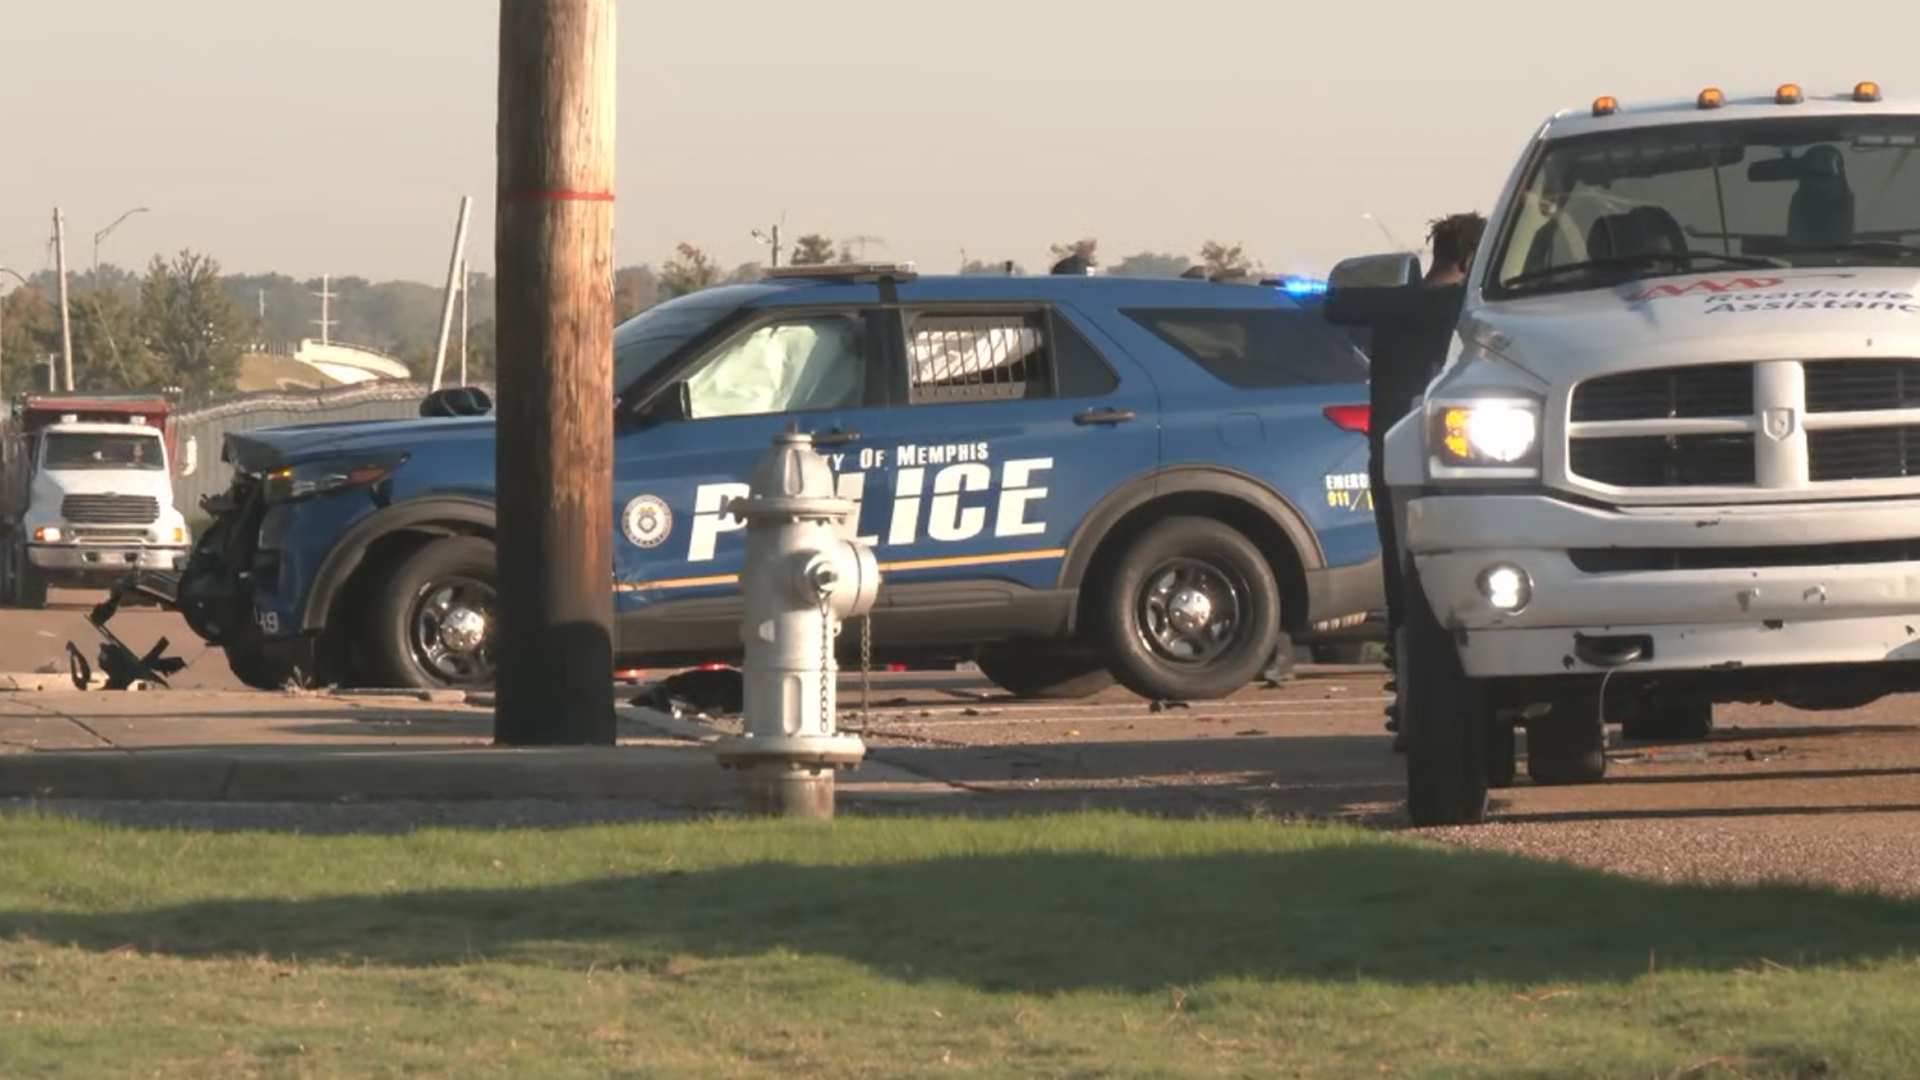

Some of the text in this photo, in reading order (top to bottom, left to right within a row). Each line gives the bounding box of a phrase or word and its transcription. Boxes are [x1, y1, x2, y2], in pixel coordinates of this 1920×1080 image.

[1704, 290, 1913, 303] Roadside
[897, 442, 989, 466] MEMPHIS
[686, 457, 1054, 562] PLICE
